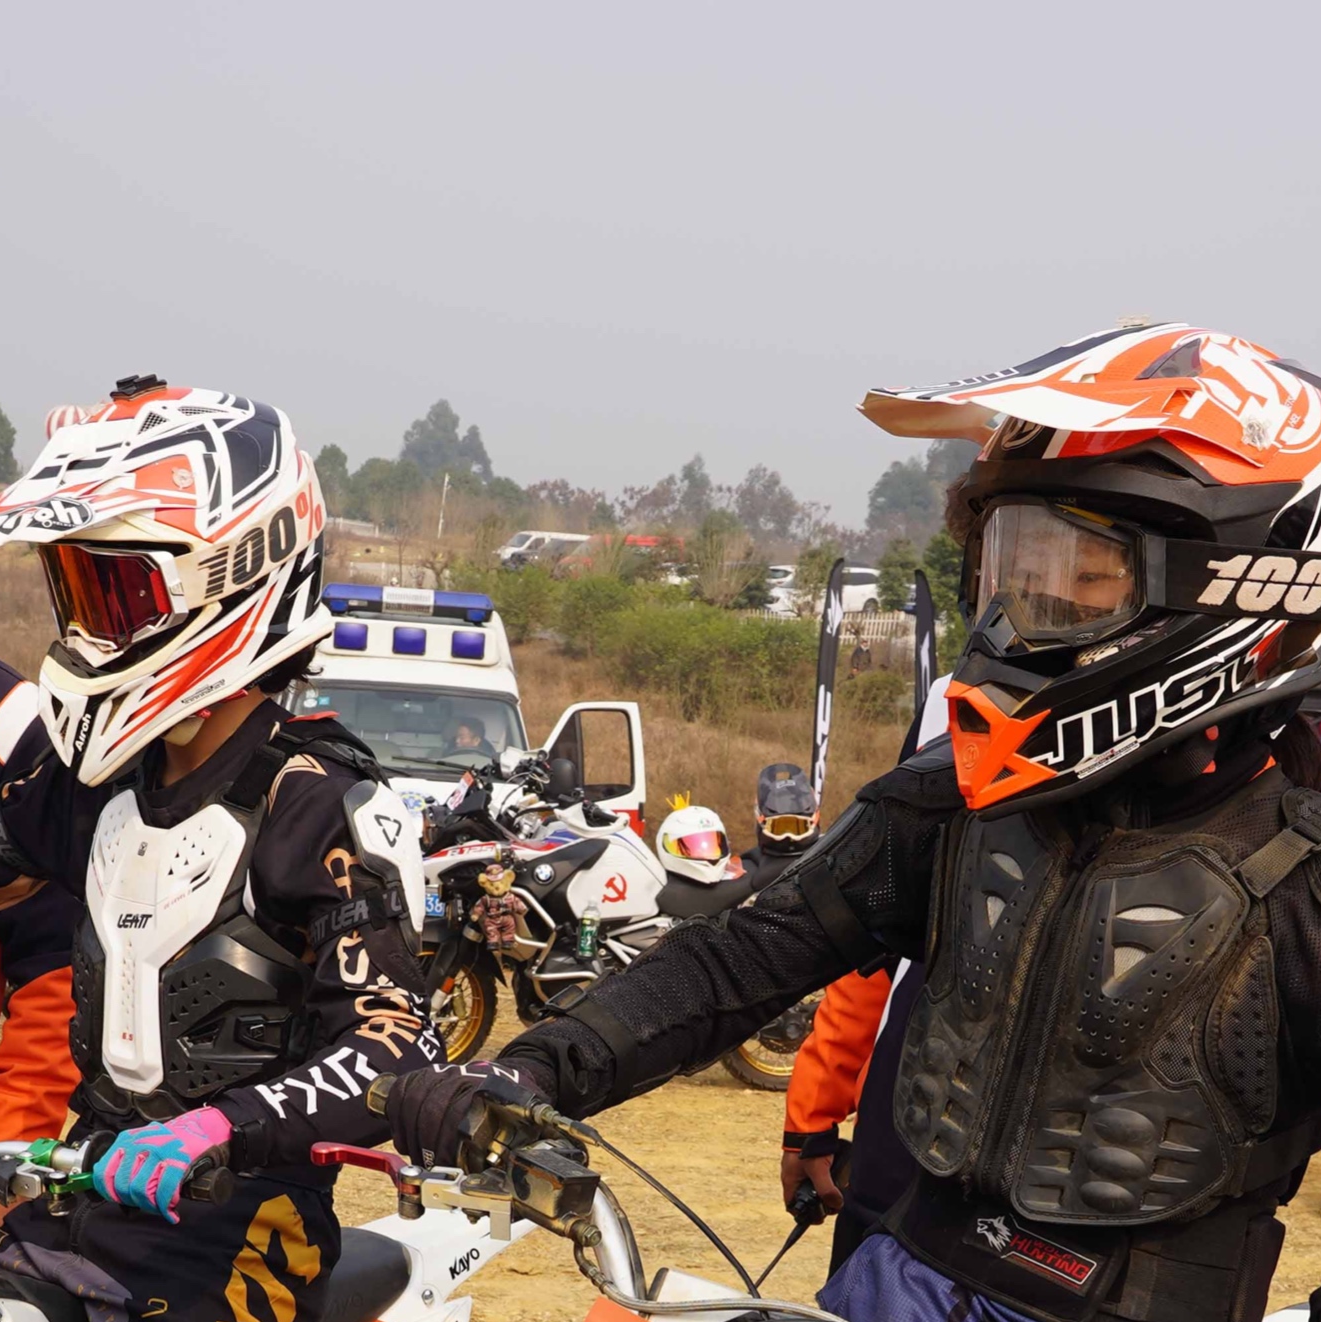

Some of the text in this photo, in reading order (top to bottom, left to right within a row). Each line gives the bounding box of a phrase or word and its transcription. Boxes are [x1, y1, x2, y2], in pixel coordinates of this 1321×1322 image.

[197, 492, 324, 600] 100%
[117, 913, 153, 929] LEATT
[448, 1247, 481, 1281] KAYO
[1009, 1233, 1091, 1281] HUNTING
